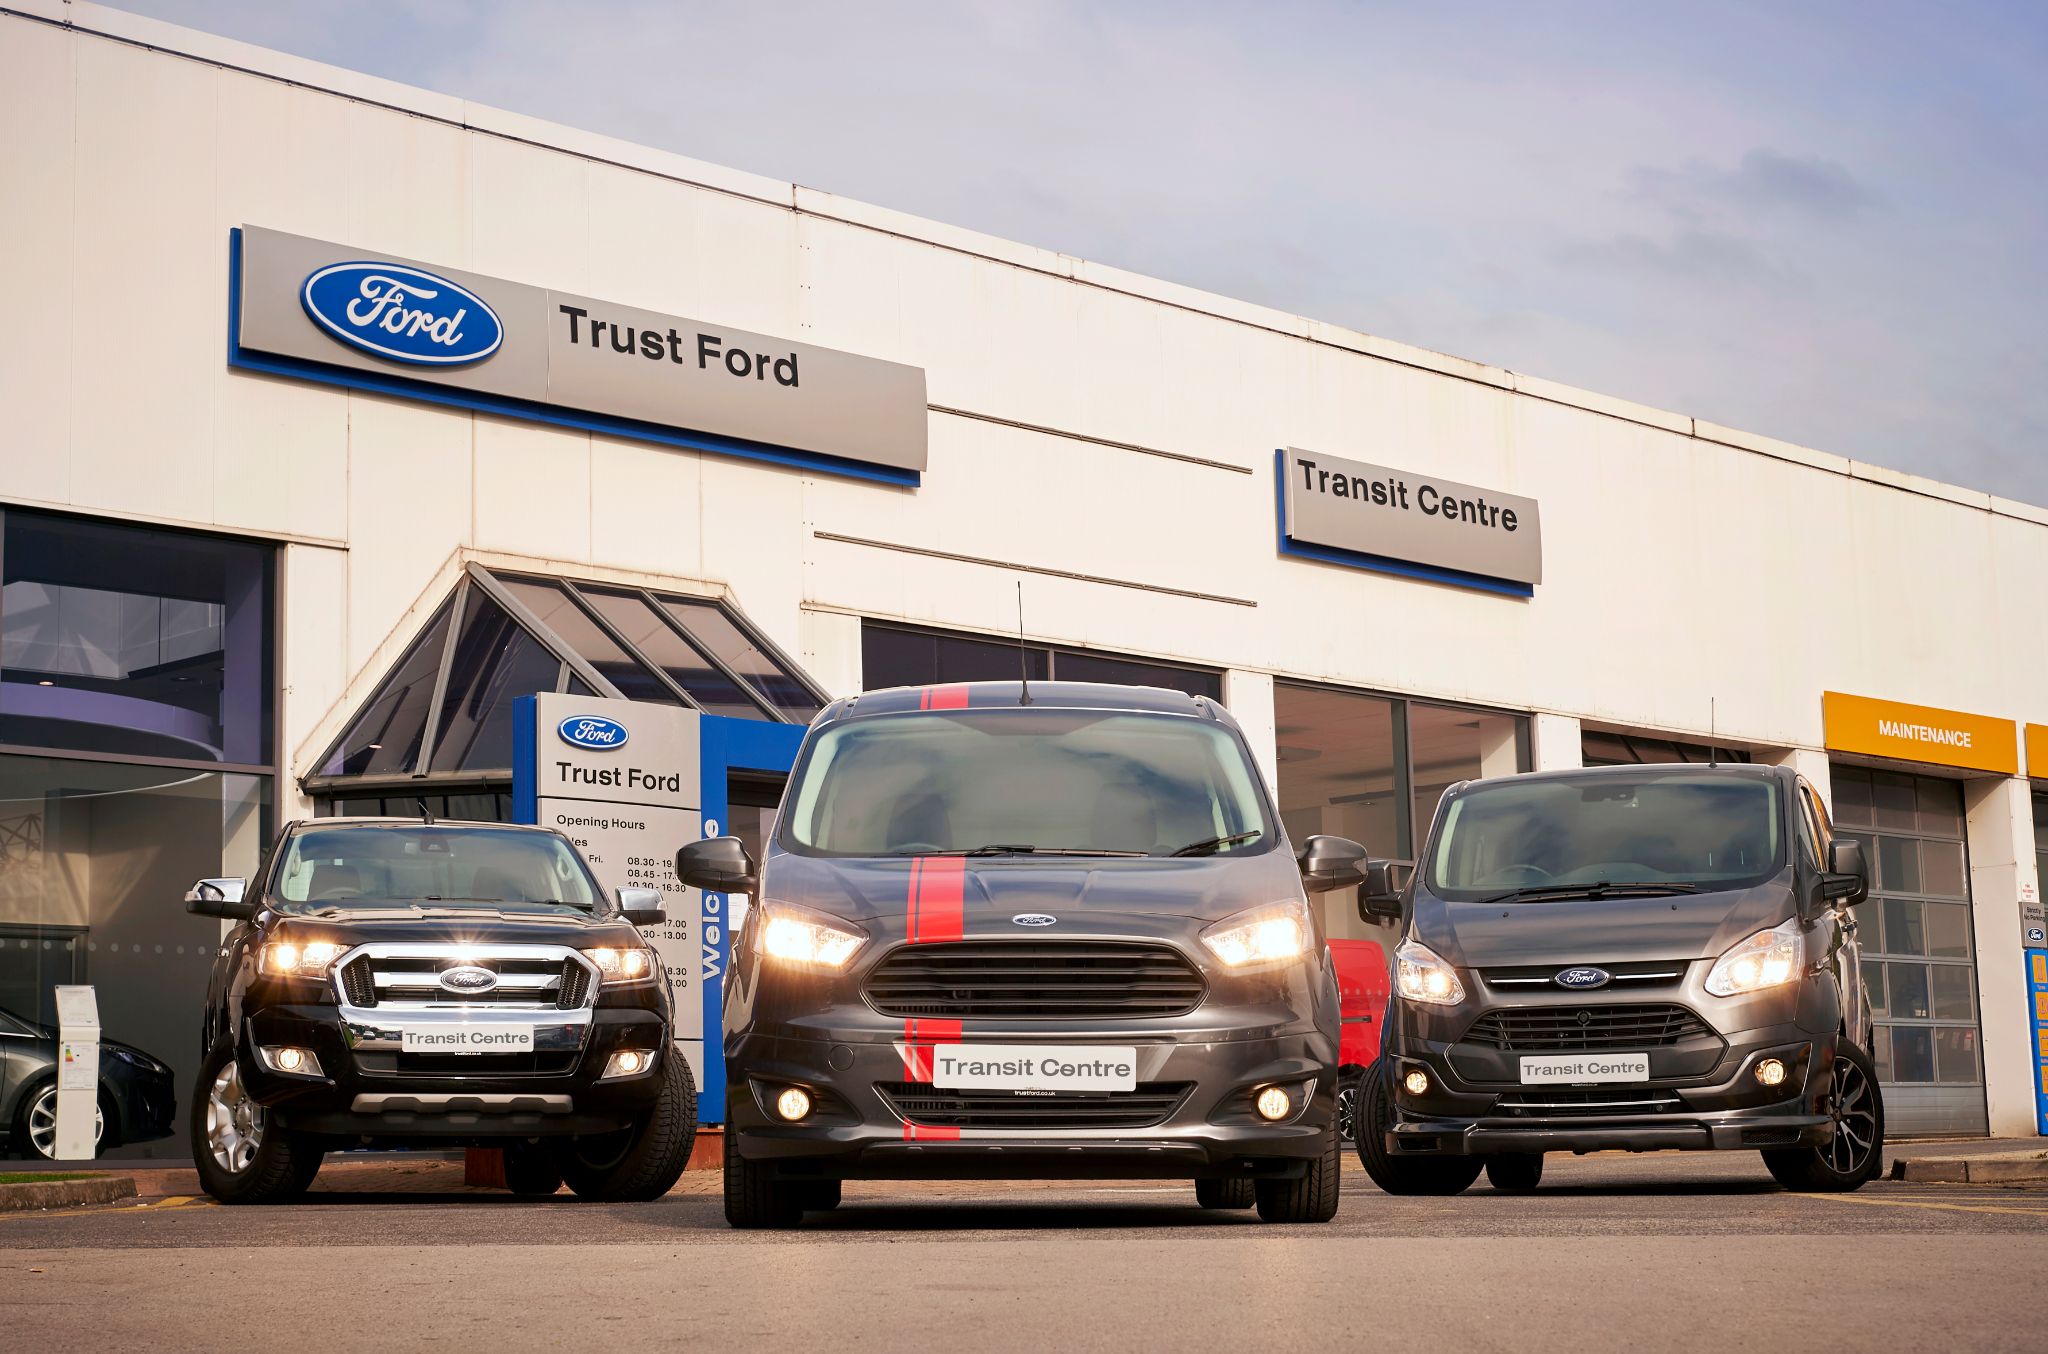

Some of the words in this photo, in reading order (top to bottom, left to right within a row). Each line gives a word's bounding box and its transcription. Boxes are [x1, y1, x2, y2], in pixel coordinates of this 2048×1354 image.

[346, 273, 467, 348] Ford
[559, 304, 683, 366] Trust
[697, 333, 801, 388] Ford
[1297, 458, 1410, 510] Transit
[1417, 485, 1518, 532] Centre
[574, 719, 616, 744] Ford
[1878, 719, 1972, 748] MAINTENANCE
[556, 761, 622, 787] Trust
[628, 768, 681, 792] Ford
[556, 814, 609, 830] Opening
[611, 818, 646, 830] Hours
[588, 854, 604, 863] Fri.
[627, 856, 655, 867] 08.30
[662, 859, 675, 868] 19.
[627, 869, 655, 878] 08.45
[663, 871, 677, 880] 17.
[627, 881, 654, 889] 1030
[662, 883, 686, 893] 16.30
[702, 819, 721, 980] Welce
[663, 931, 687, 940] 13.00
[667, 967, 687, 976] 8.30
[1566, 970, 1597, 983] Ford
[405, 1033, 467, 1044] Transit
[470, 1032, 530, 1044] Centre
[939, 1057, 1034, 1076] Transit
[1040, 1058, 1131, 1077] Centre
[1523, 1063, 1584, 1076] Transit
[1587, 1061, 1646, 1075] Centre
